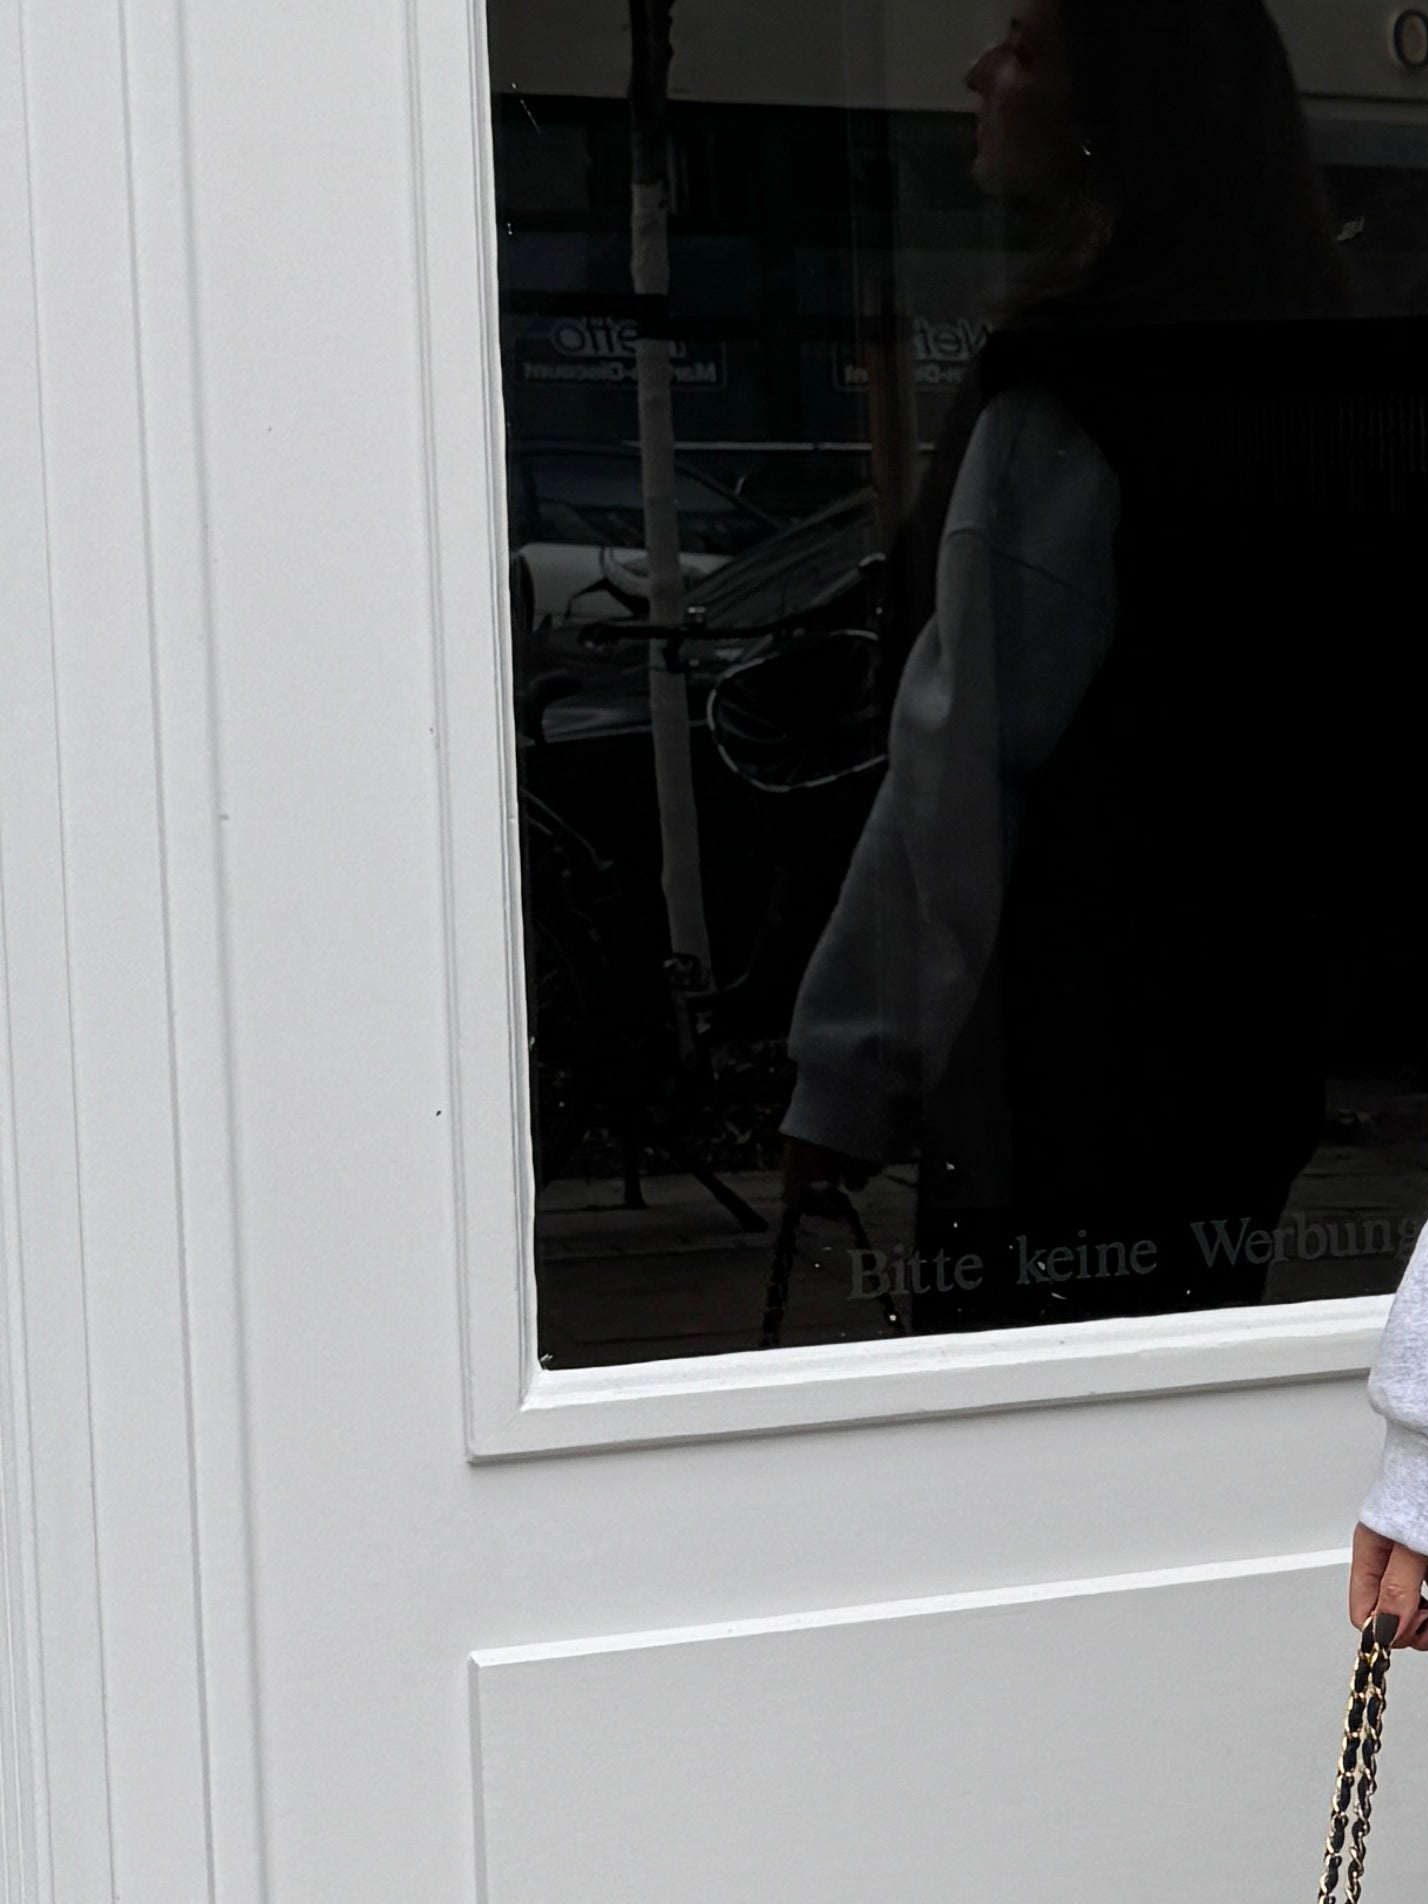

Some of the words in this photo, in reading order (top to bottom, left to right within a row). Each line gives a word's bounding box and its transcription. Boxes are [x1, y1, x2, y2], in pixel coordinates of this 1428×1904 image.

[846, 1244, 985, 1302] Bitte
[1015, 1229, 1160, 1286] keine
[1189, 1215, 1422, 1267] Werbung
